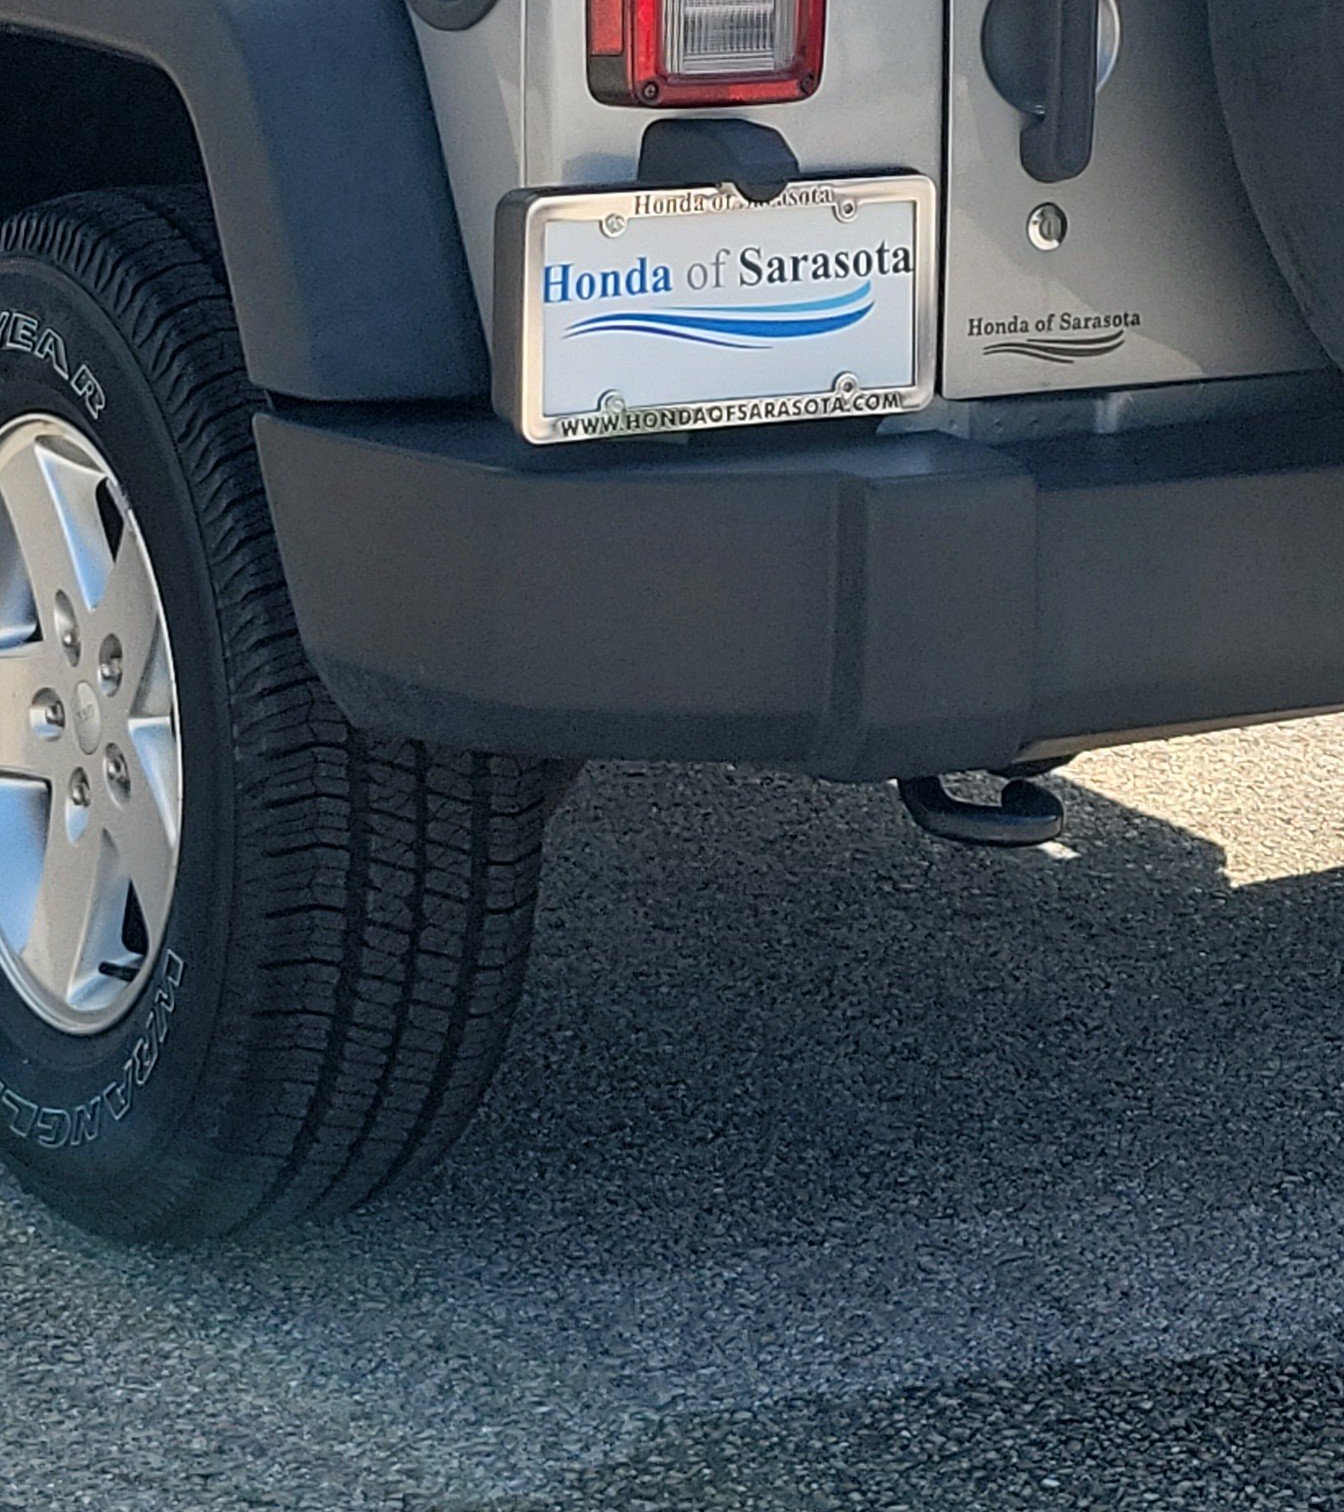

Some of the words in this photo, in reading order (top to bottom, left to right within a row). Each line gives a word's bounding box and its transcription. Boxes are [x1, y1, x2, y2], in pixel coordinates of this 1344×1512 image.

[634, 193, 704, 215] Honda
[543, 256, 673, 304] Honda
[686, 249, 731, 290] of
[738, 240, 913, 288] Sarasota
[968, 316, 1029, 336] Honda
[1035, 314, 1055, 331] of
[1059, 311, 1141, 330] Sarasota
[561, 392, 902, 437] WWW.HONDAOFSARASOTA.COM
